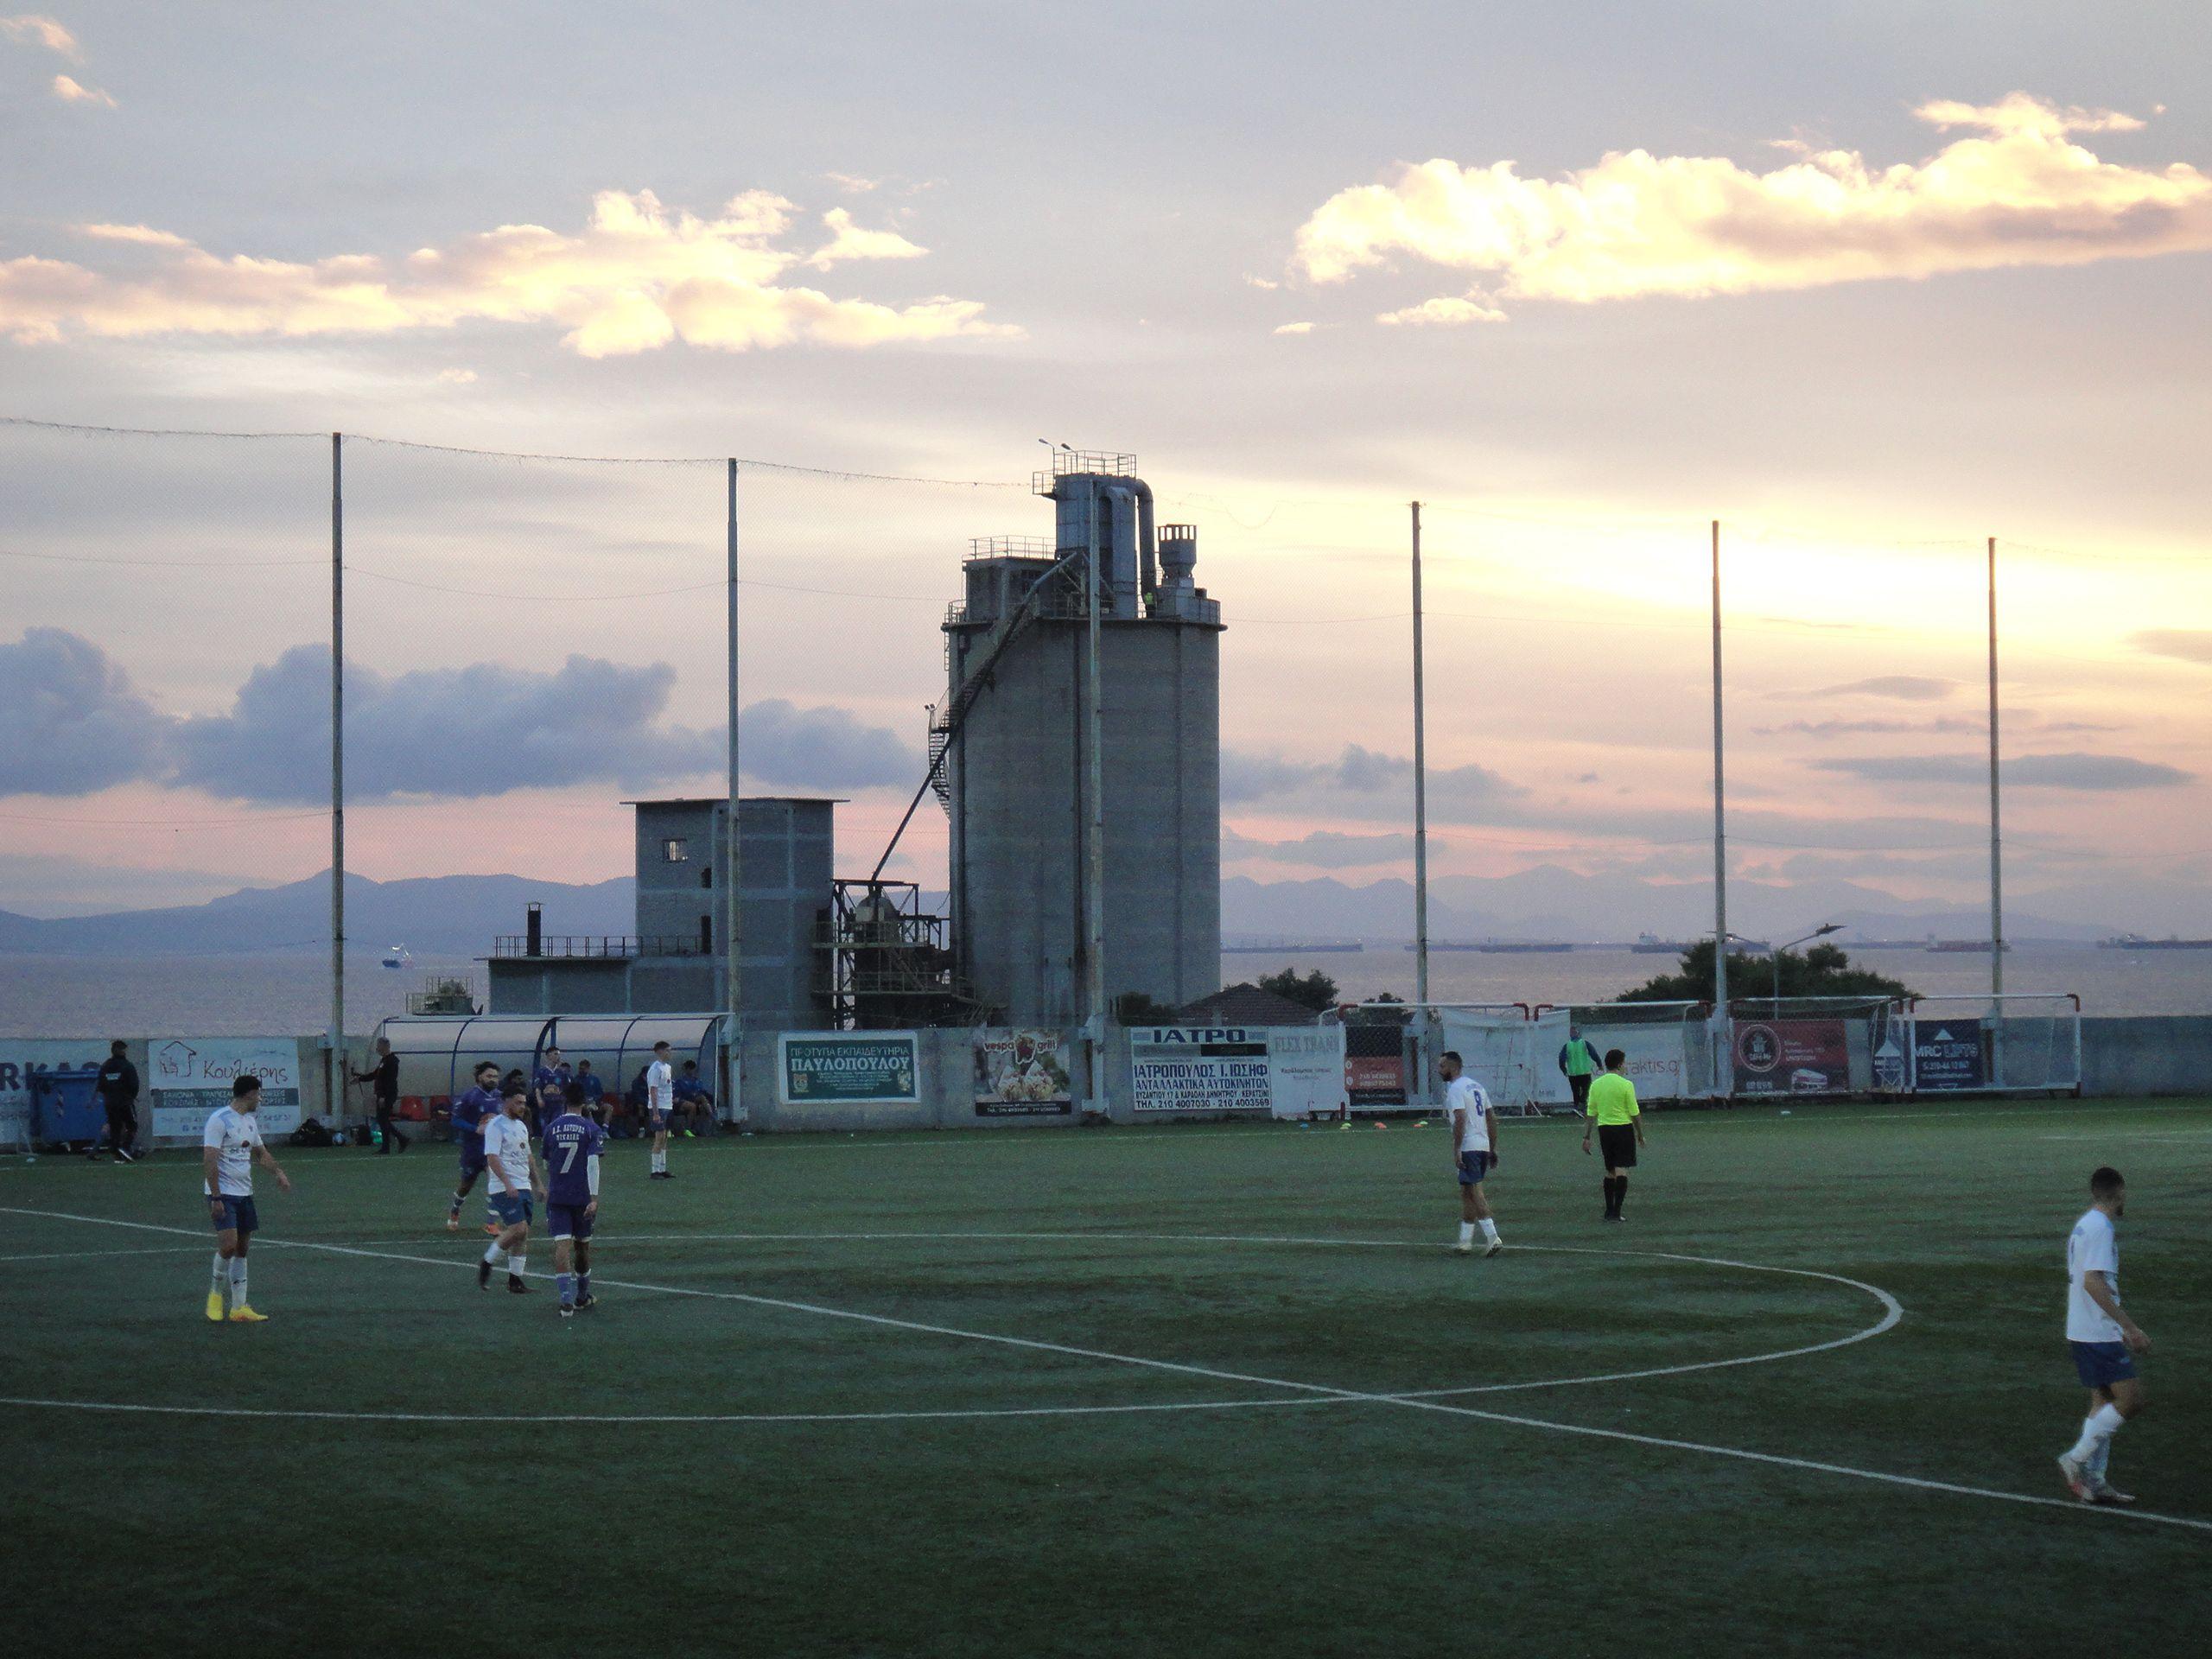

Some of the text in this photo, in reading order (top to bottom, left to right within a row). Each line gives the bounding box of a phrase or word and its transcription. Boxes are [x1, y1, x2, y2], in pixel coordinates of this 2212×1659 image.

[1154, 1029, 1245, 1043] ΙΑΤΡΟ
[984, 1039, 1056, 1052] vespa grill
[791, 1057, 910, 1071] ΠΑΥΛΟΠΟΥΛΟΥ
[1134, 1065, 1215, 1078] ΙΑΤΡΟΠΟΥΛΟΣ
[1230, 1064, 1268, 1077] ΙΩΣΗΦ
[1135, 1078, 1268, 1090] ΑΝΤΑΛΛΑΚΤΙΚΑ ΑΥΤΟΚΙΝΗΤΩΝ
[1136, 1100, 1154, 1109] ΤΗΛ.
[1158, 1099, 1173, 1108] 210
[1176, 1099, 1210, 1108] 4007030
[1473, 1090, 1484, 1116] 8
[558, 1141, 578, 1173] 7
